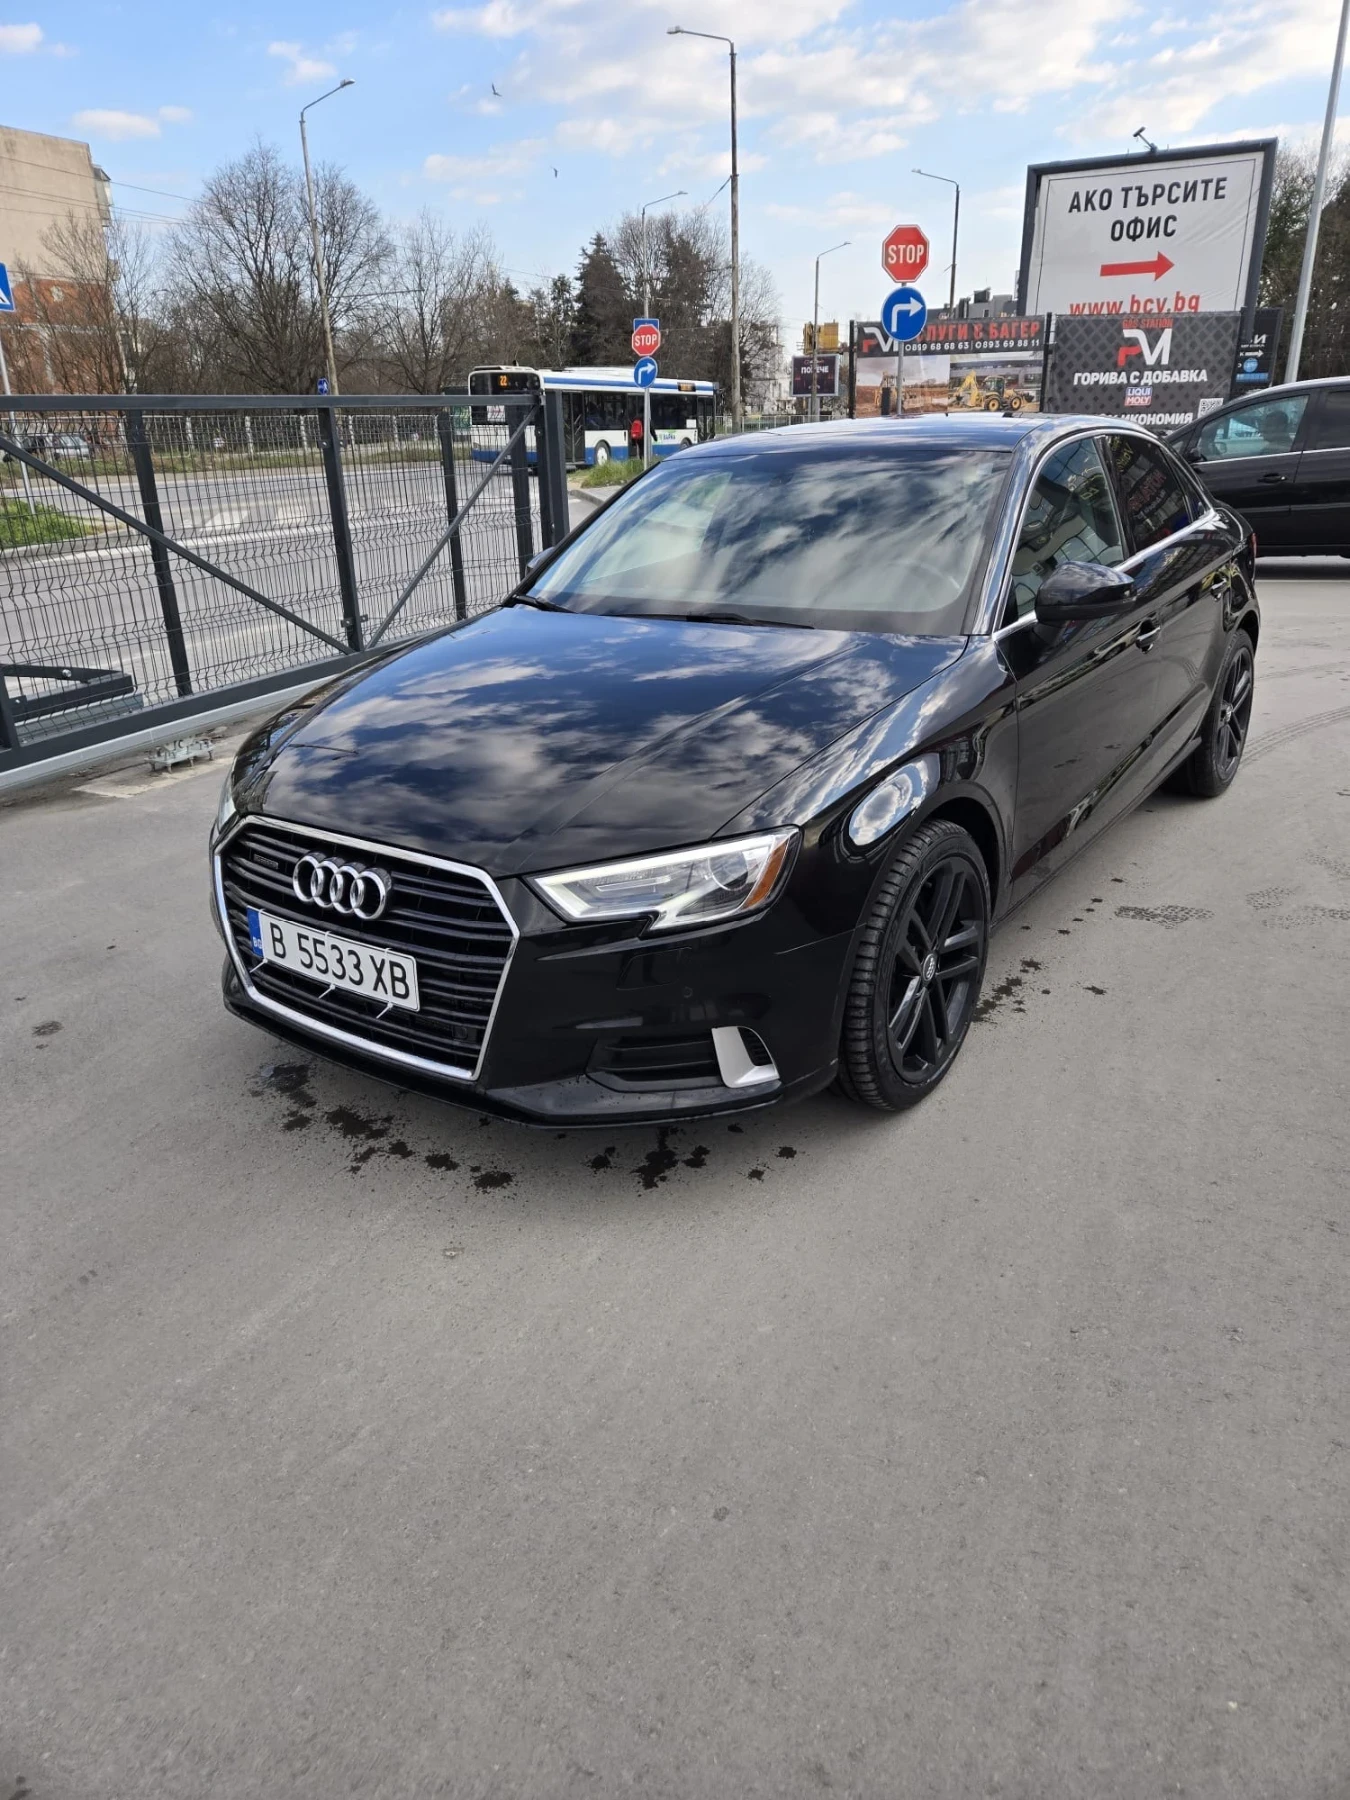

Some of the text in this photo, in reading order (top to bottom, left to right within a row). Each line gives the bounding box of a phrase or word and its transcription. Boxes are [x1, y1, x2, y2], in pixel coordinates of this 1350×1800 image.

[1068, 177, 1227, 213] АКО ТЪРСИТЕ
[1111, 214, 1177, 242] ОФИС
[888, 244, 924, 264] STOP
[989, 321, 1040, 340] БАГЕР
[635, 333, 657, 347] STOP
[930, 342, 941, 350] 68
[944, 342, 955, 350] 68
[958, 341, 969, 350] 63
[975, 340, 1000, 349] 0893
[1003, 339, 1015, 348] 69
[1017, 339, 1028, 347] 88
[1031, 338, 1040, 347] 11
[500, 375, 507, 386] 22
[1073, 369, 1208, 386] ГОРИВА С ДОБАВКА
[1127, 387, 1151, 396] LIQUI
[1126, 396, 1151, 405] MOLY
[270, 922, 410, 1000] B 5533 XB
